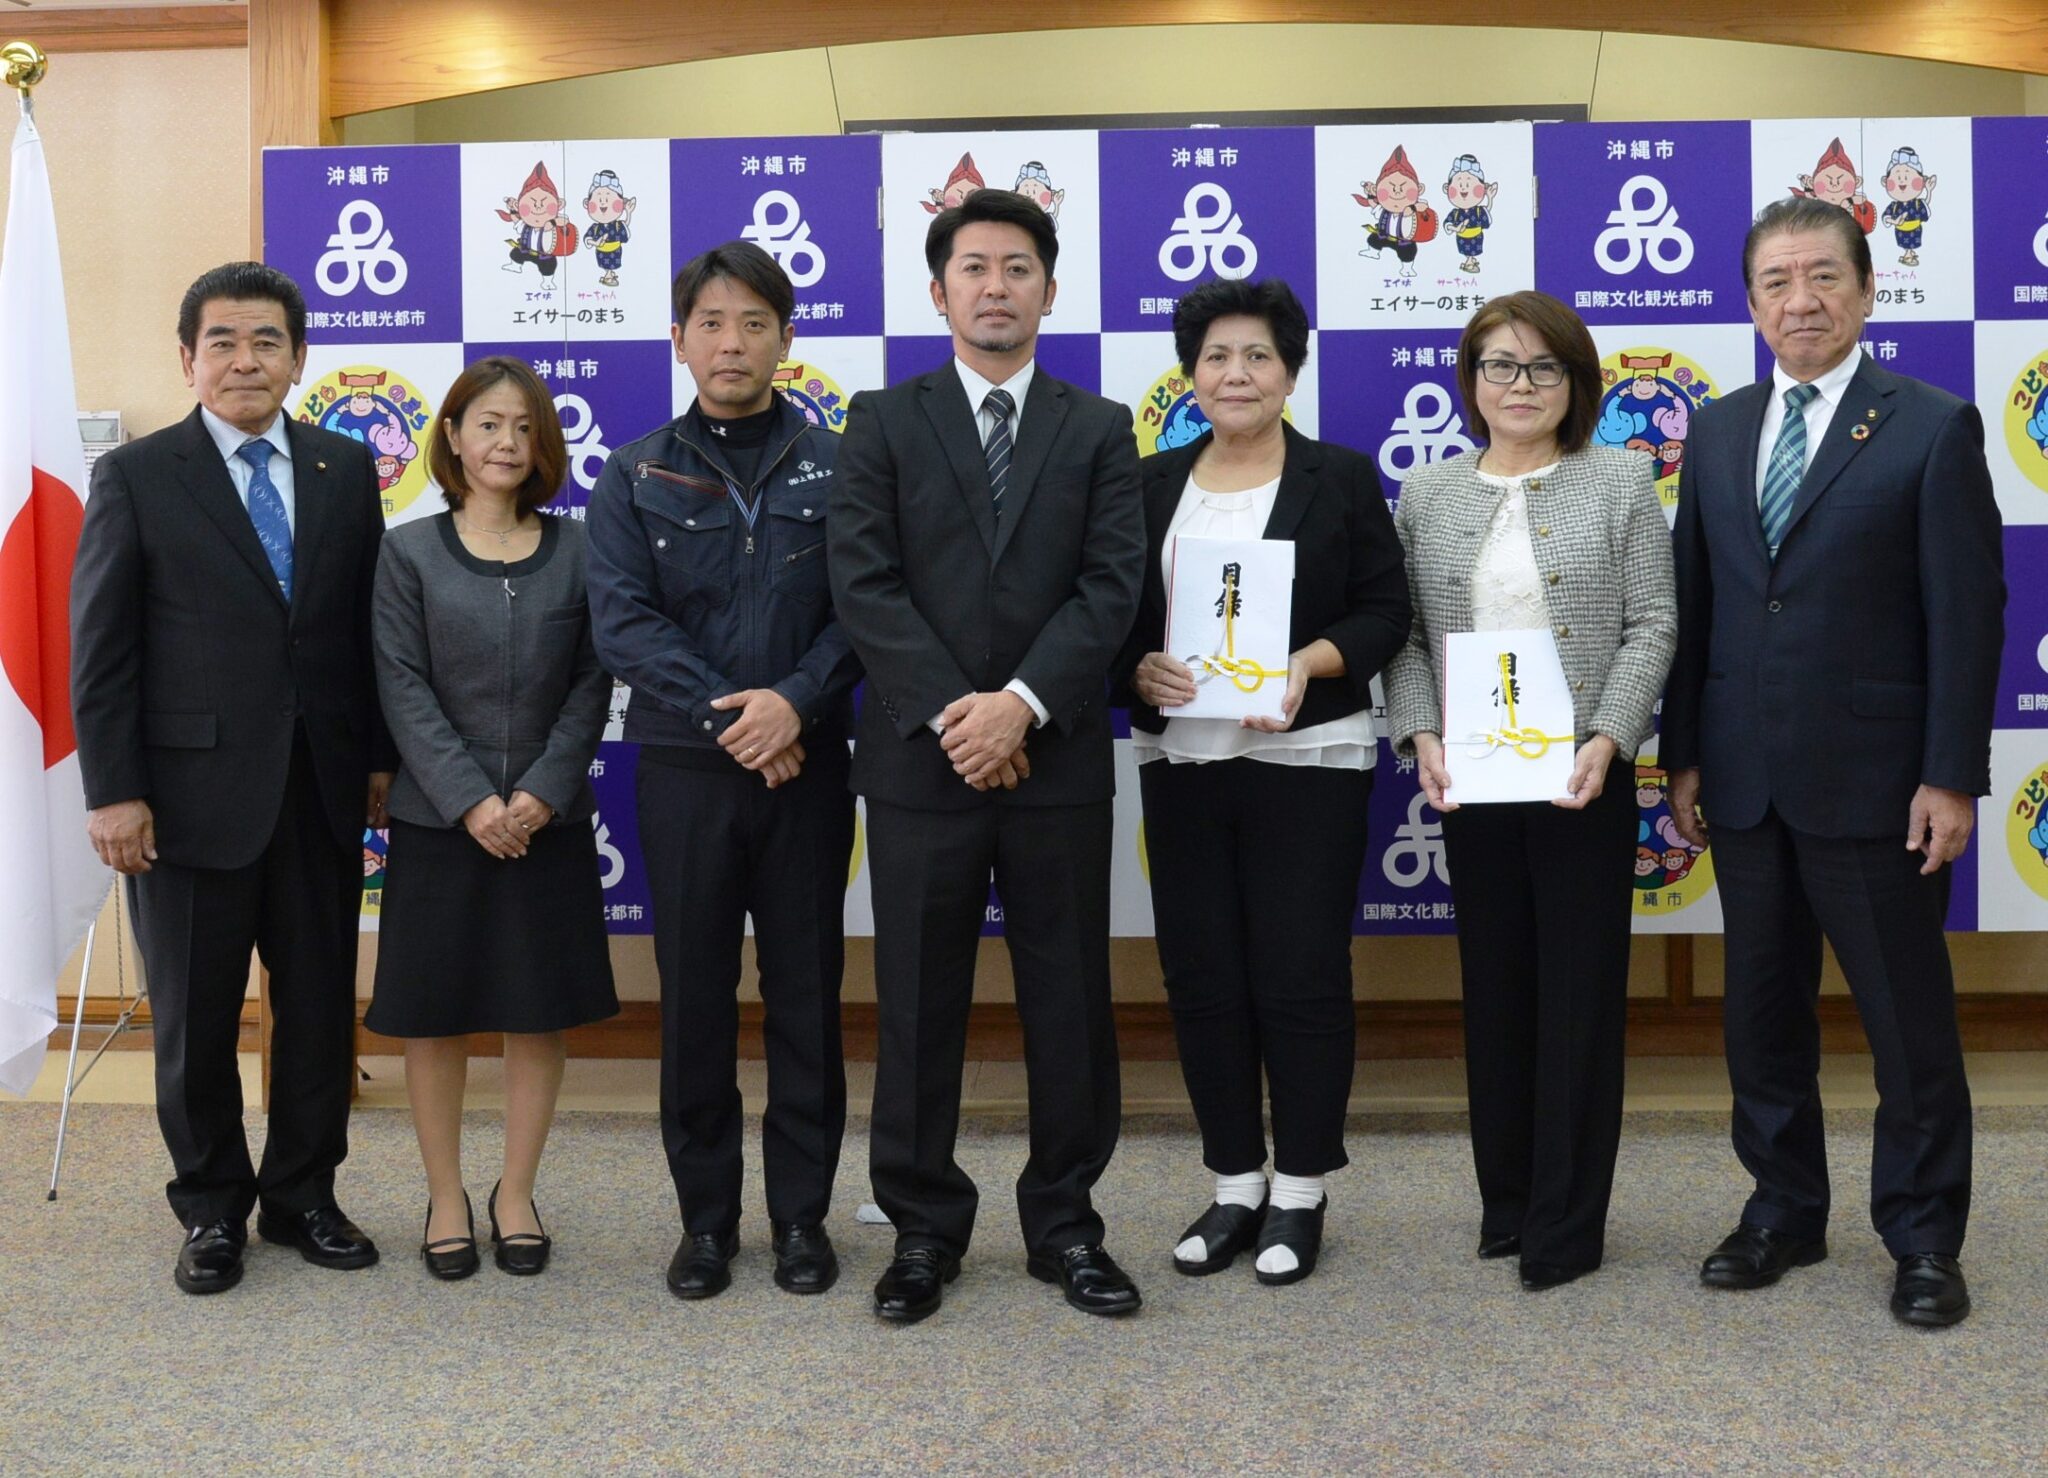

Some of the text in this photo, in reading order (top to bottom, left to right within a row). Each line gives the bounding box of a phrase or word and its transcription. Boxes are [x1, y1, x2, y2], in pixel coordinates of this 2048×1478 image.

[1171, 147, 1239, 168] 沖縄市
[1607, 139, 1674, 160] 沖縄市
[327, 165, 390, 186] 沖縄市
[741, 155, 807, 176] 沖縄市
[1370, 294, 1486, 312] エイサーのまち
[1575, 289, 1713, 308] 国際文化観光都市
[1876, 287, 1925, 304] のまち
[513, 307, 625, 325] エイサーのまち
[789, 302, 845, 320] 光都市
[1140, 297, 1179, 315] 国際
[1391, 346, 1459, 368] 沖縄市
[533, 359, 599, 379] 沖縄市
[1214, 562, 1242, 619] 目録
